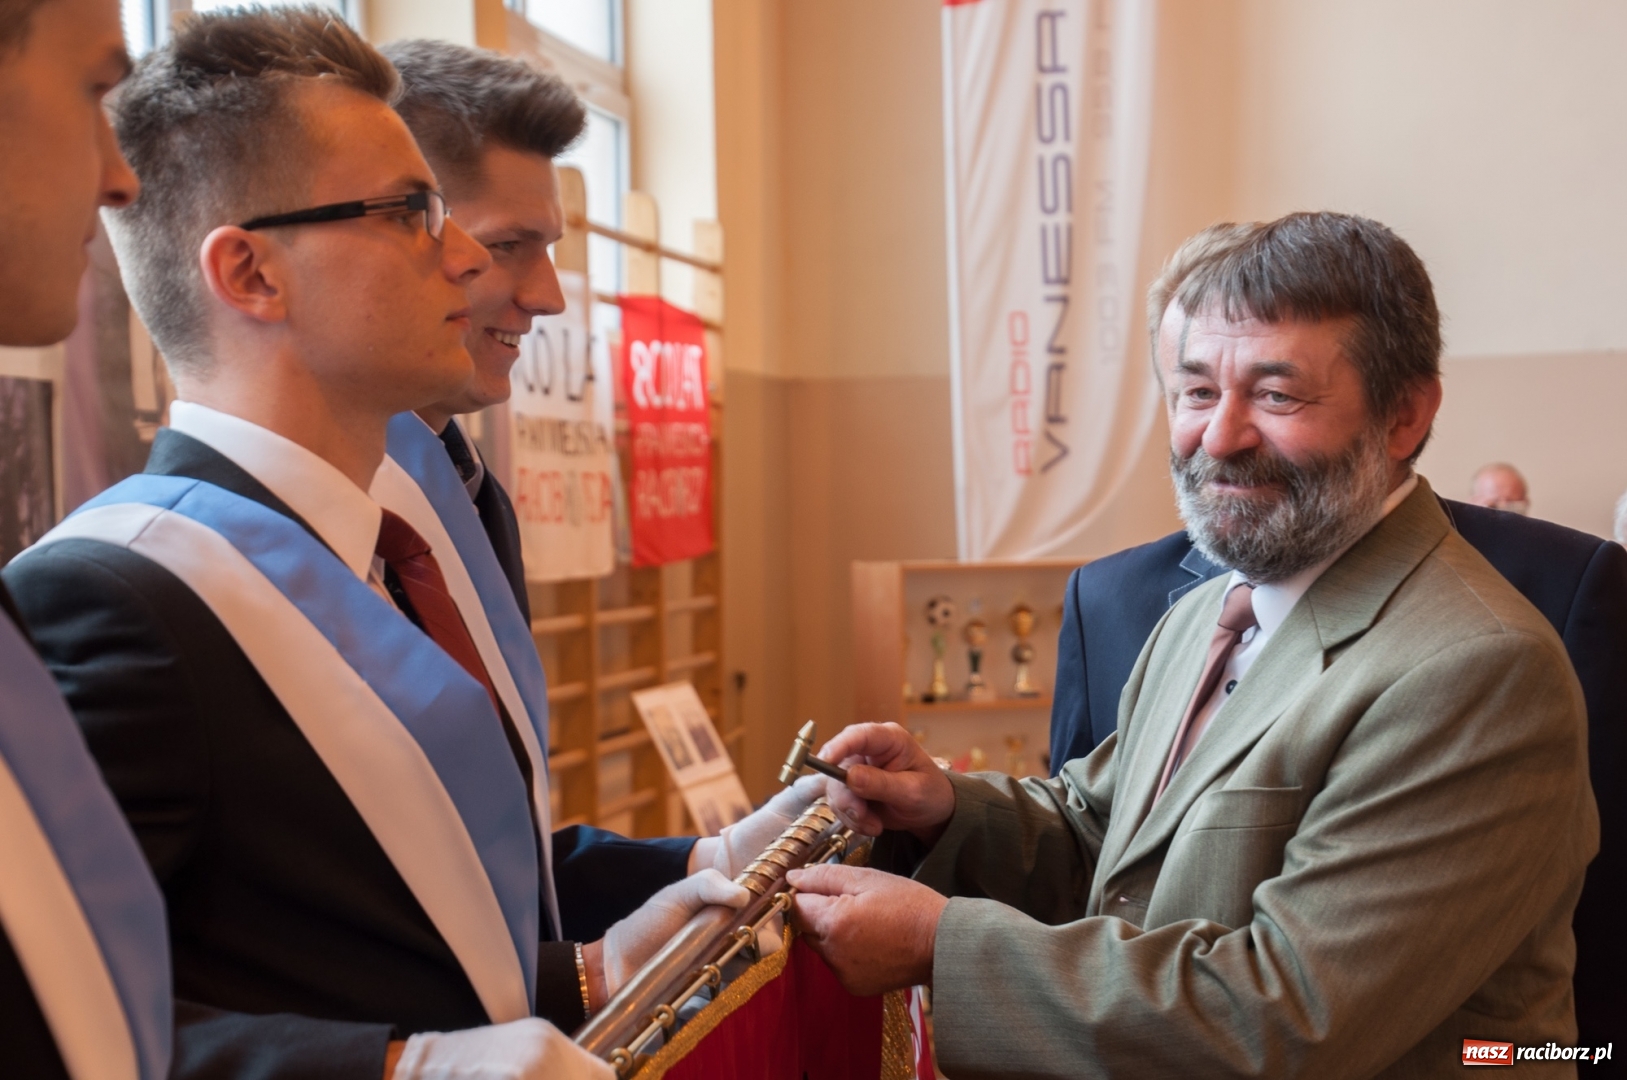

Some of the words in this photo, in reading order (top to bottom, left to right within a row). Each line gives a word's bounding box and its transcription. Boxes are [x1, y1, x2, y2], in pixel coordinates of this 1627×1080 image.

[1037, 9, 1073, 474] VANESSA
[1094, 179, 1115, 247] FM
[1008, 311, 1032, 476] RADIO
